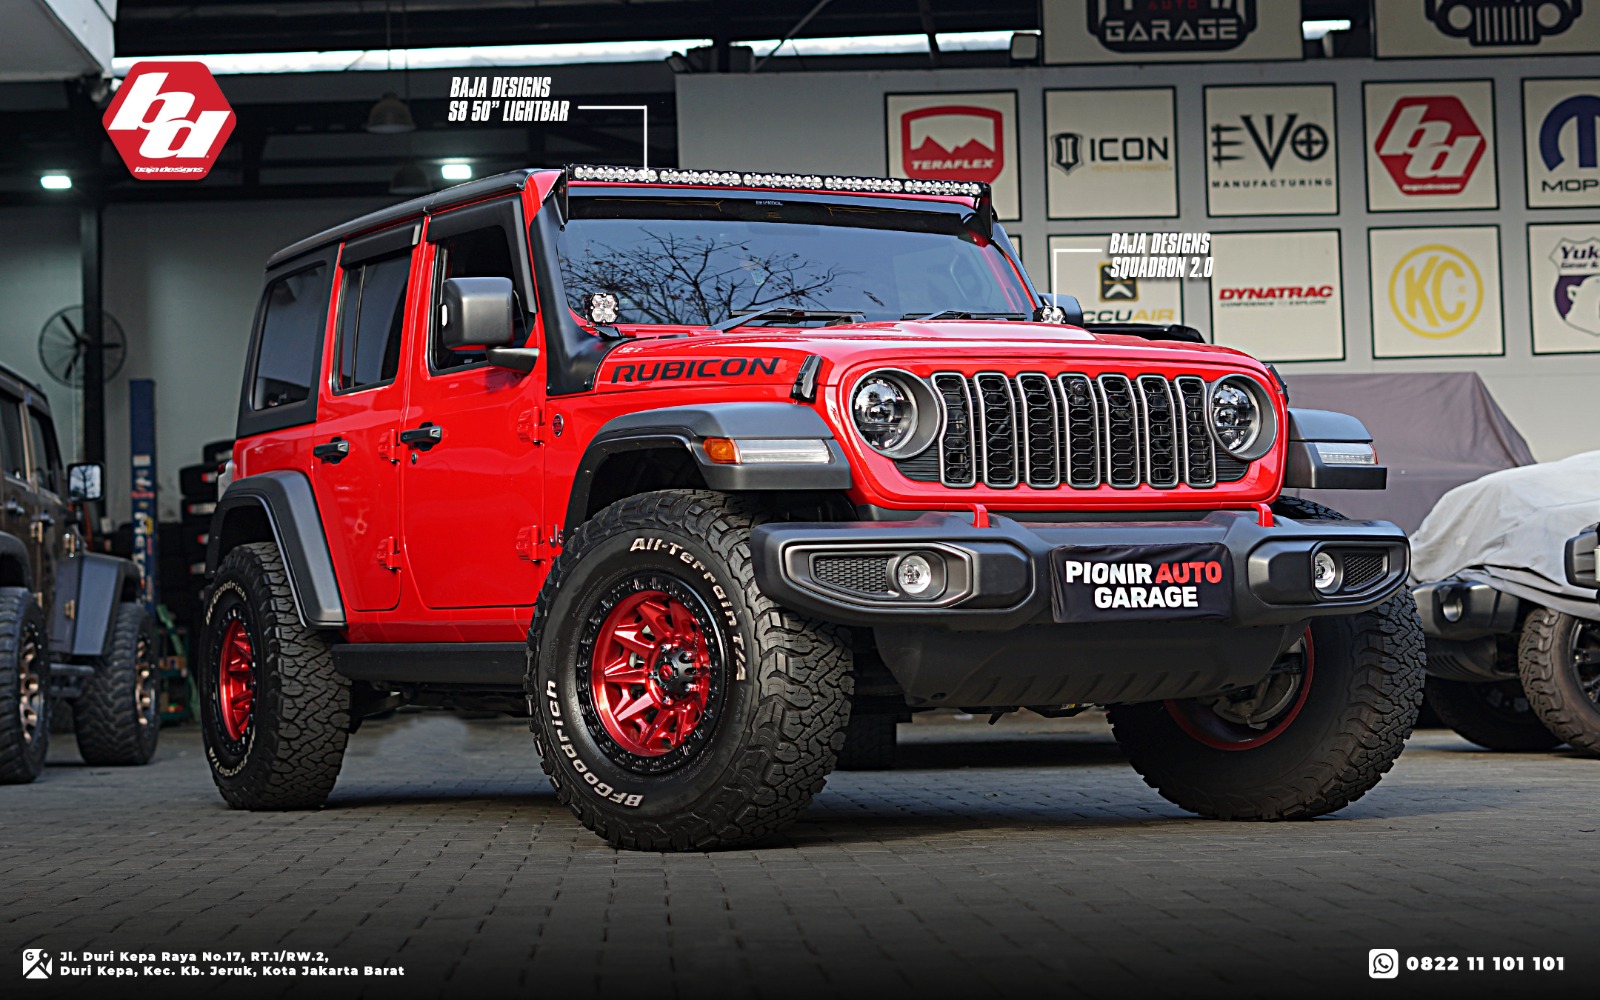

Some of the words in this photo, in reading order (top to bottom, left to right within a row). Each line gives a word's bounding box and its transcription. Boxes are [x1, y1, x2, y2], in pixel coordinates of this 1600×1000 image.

[1105, 18, 1238, 42] GARAGE
[1090, 136, 1168, 162] ICON
[911, 158, 995, 171] TERAFLEX
[1212, 178, 1333, 188] MANUFACTURING
[1218, 285, 1334, 300] DYNATRAC
[1083, 309, 1175, 323] CCUAIR
[611, 357, 780, 384] RUBICON
[629, 537, 738, 627] All-Terrain
[1065, 560, 1154, 585] PIONIR
[1155, 561, 1223, 584] AUTO
[1094, 586, 1199, 609] GARAGE
[546, 680, 645, 807] BFGoodrich
